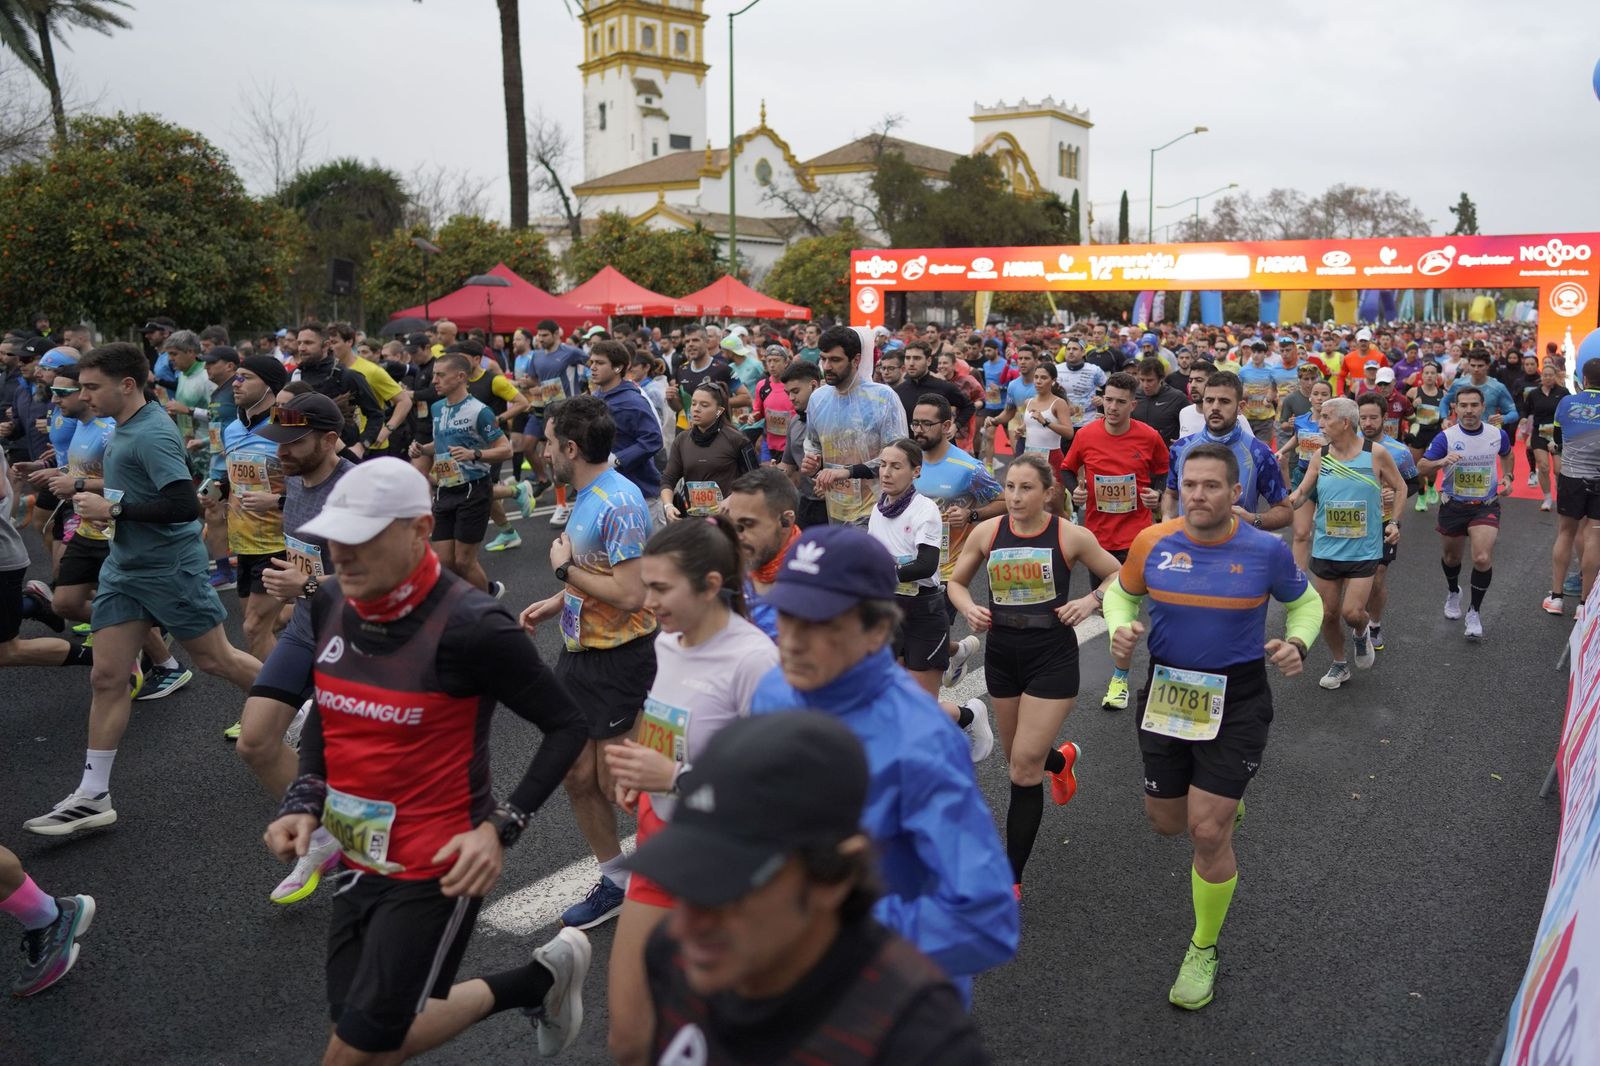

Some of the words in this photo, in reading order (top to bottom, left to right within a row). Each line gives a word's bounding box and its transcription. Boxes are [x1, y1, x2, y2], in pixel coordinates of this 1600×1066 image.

[1255, 255, 1309, 273] HOKA
[232, 463, 256, 479] 7508
[1459, 473, 1483, 484] 9314
[1100, 485, 1127, 497] 7931
[1328, 509, 1361, 522] 10216
[993, 562, 1042, 582] 13100
[315, 686, 424, 725] UROSANGUE
[1157, 683, 1211, 712] 10781
